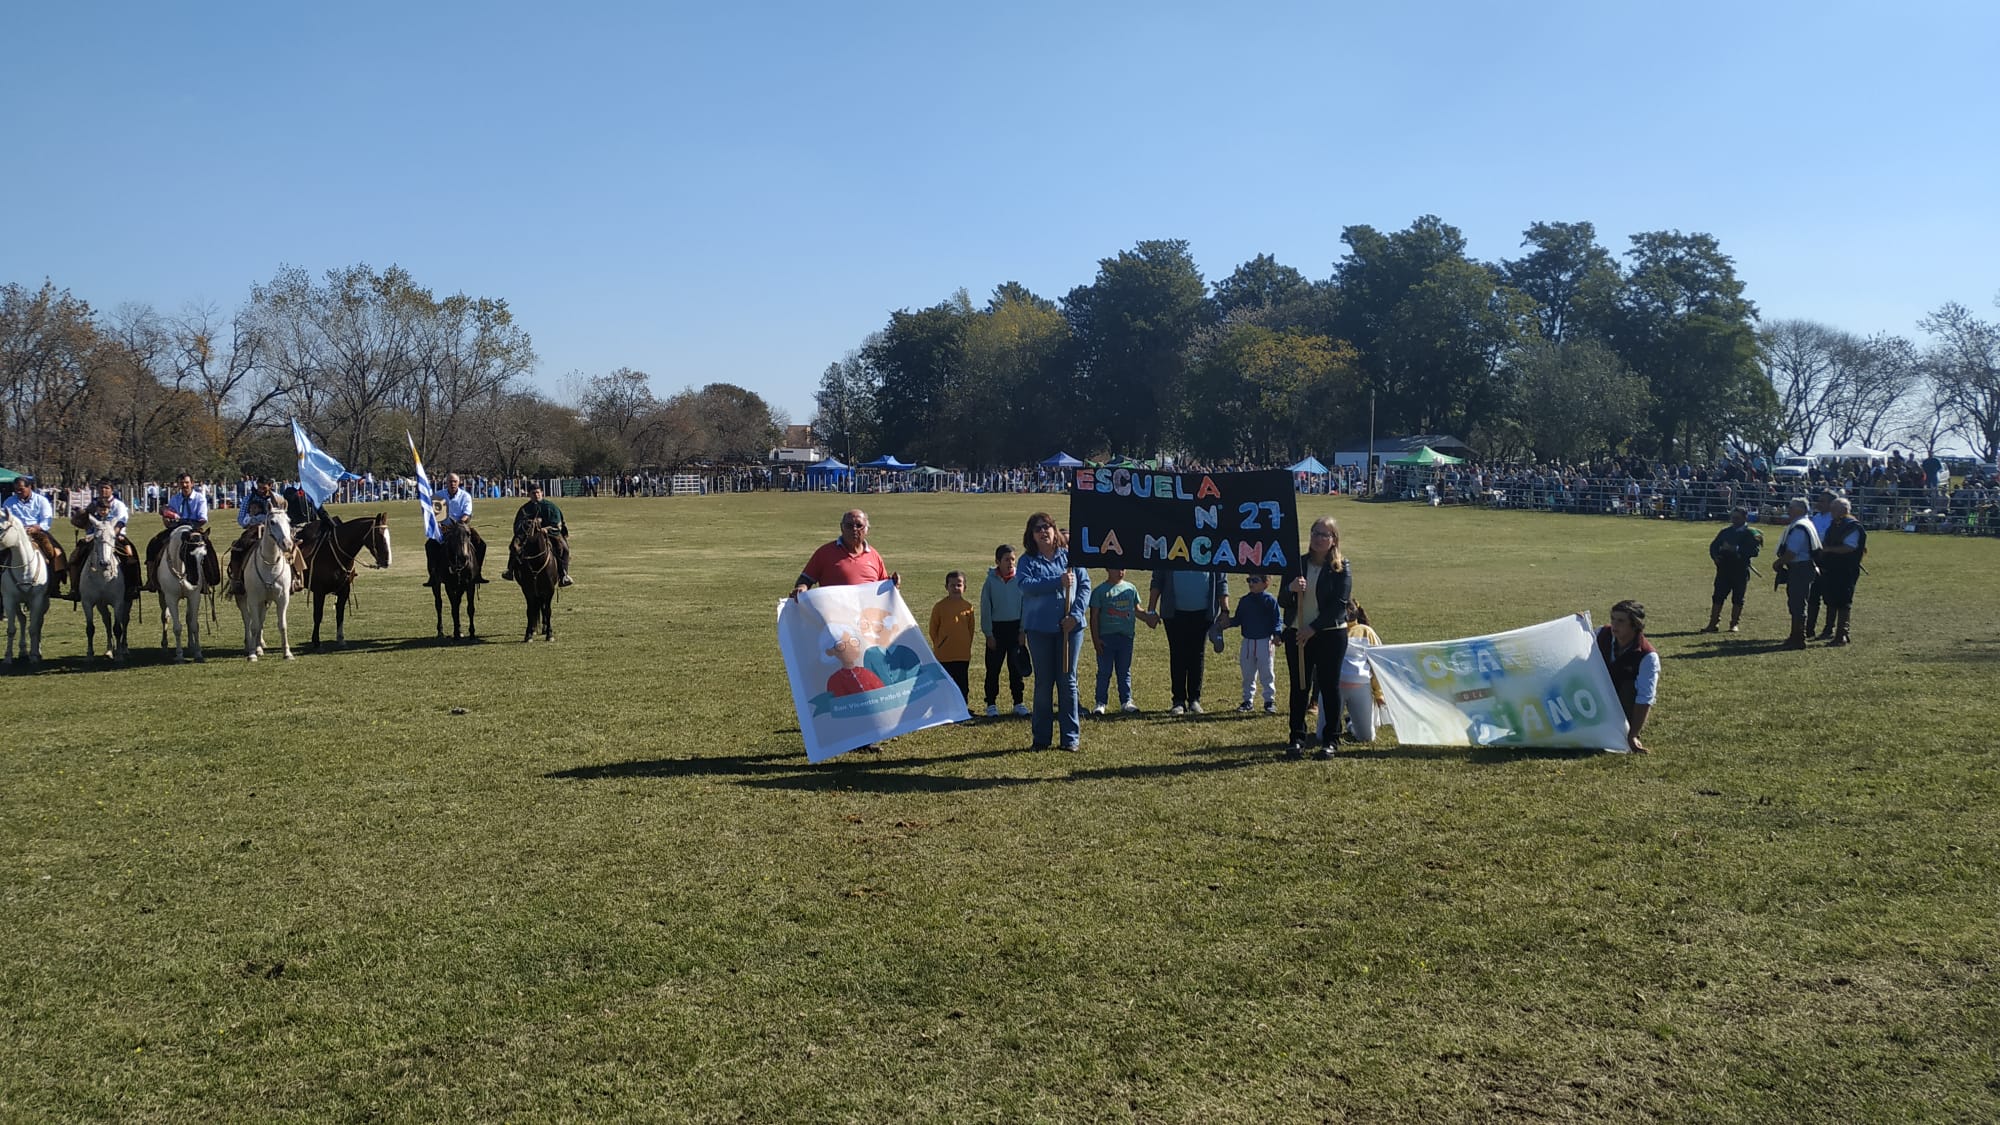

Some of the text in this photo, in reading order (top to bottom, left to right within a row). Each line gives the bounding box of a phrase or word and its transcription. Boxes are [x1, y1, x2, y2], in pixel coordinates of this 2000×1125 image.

[1076, 468, 1221, 500] ESCUELA
[1238, 501, 1285, 530] 27
[1081, 526, 1288, 567] LA MACANA
